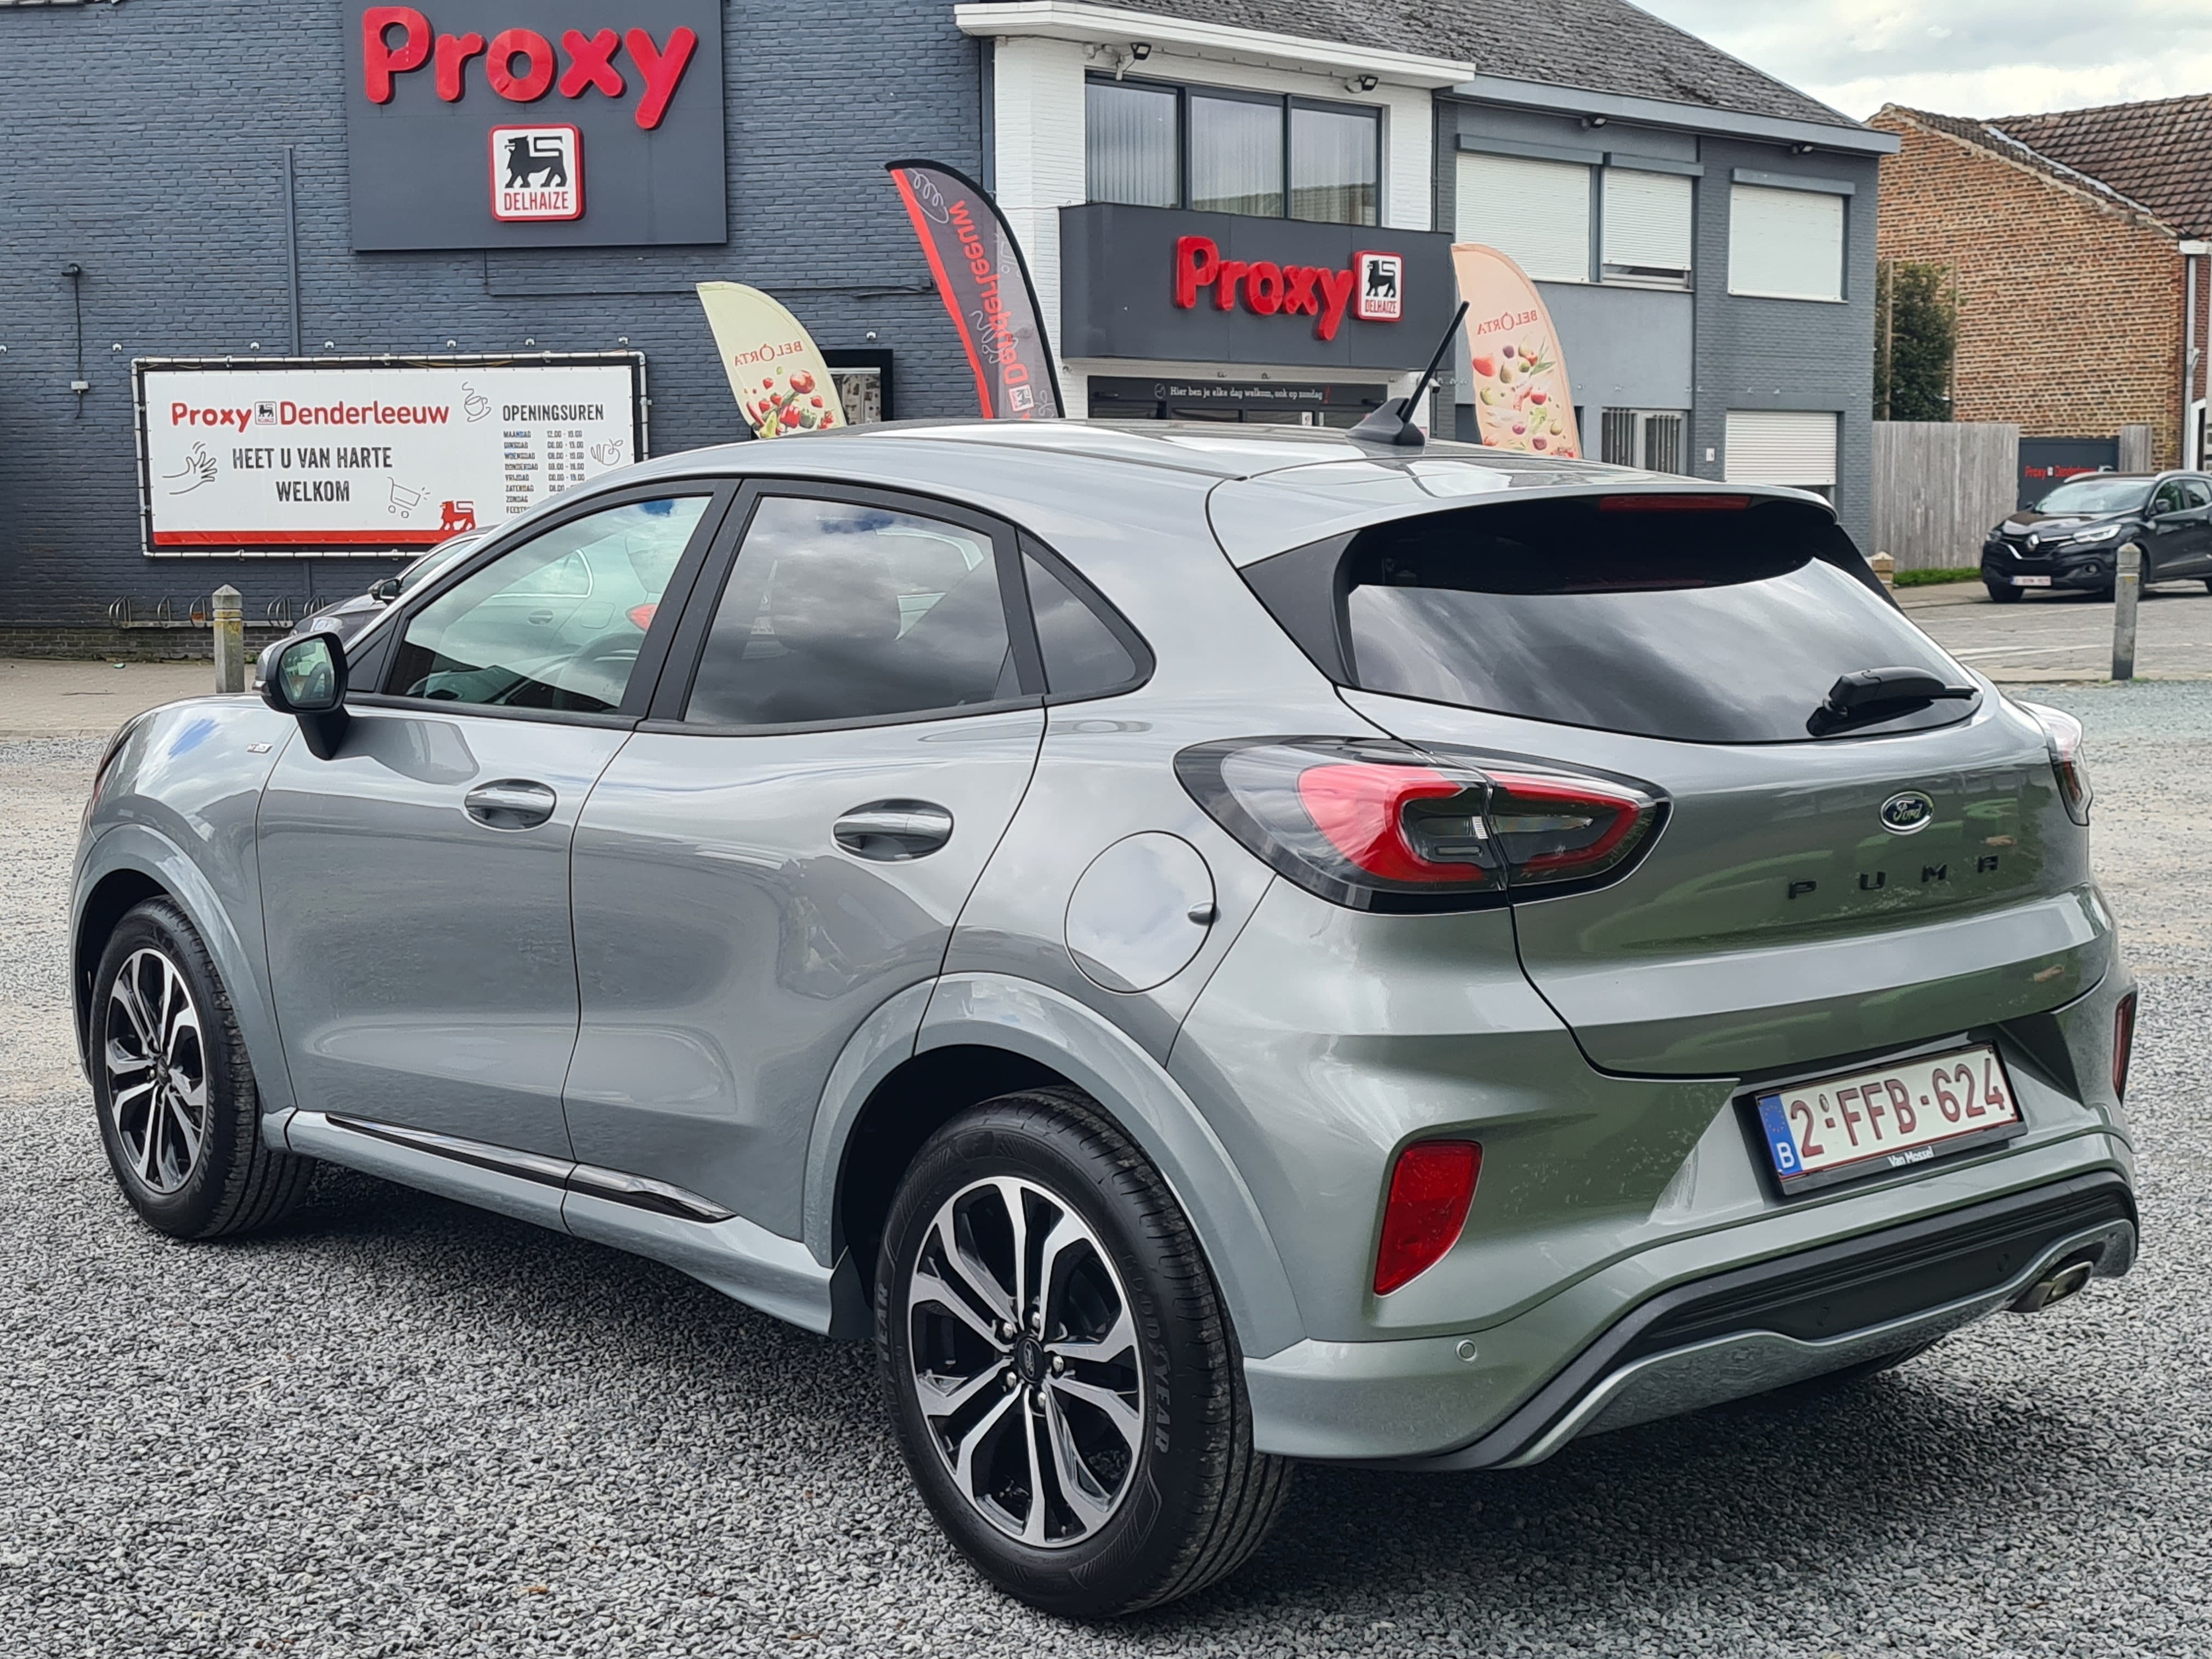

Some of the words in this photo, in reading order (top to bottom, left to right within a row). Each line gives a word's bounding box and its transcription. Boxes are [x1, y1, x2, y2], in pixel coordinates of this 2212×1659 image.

[362, 6, 698, 130] Proxy
[503, 191, 569, 212] DELHAIZE
[1176, 235, 1355, 341] Proxy
[1365, 298, 1397, 314] DELHAIZE
[1170, 386, 1187, 396] Hier
[172, 402, 252, 432] Proxy
[280, 400, 449, 425] Denderleeuw
[503, 404, 604, 421] OPENINGSUREN
[232, 448, 275, 469] HEET
[280, 448, 292, 469] U
[297, 447, 330, 469] VAN
[337, 447, 393, 469] HARTE
[275, 481, 350, 502] WELKOM
[1893, 799, 1923, 822] Ford
[1787, 854, 1999, 900] PUMA
[1776, 1142, 1796, 1169] B
[1887, 1154, 1907, 1168] Van
